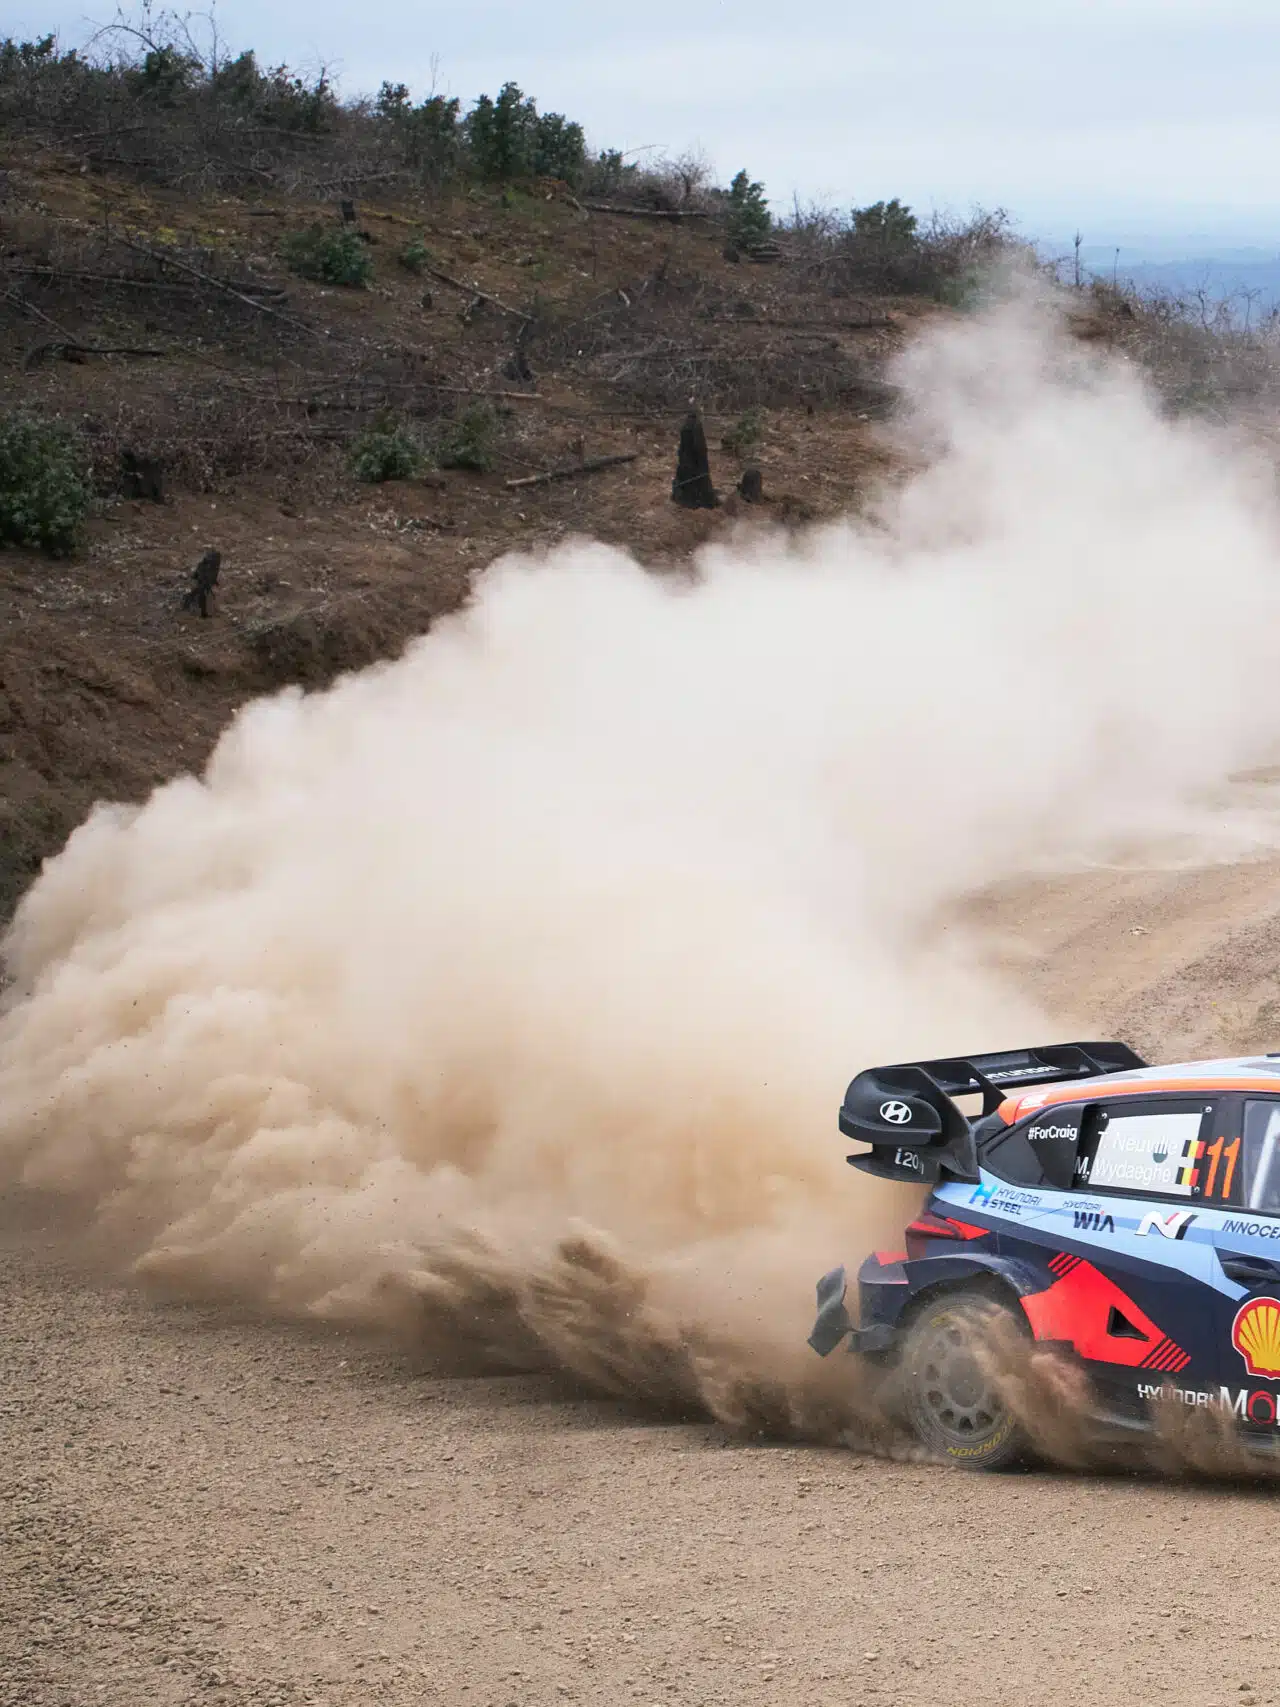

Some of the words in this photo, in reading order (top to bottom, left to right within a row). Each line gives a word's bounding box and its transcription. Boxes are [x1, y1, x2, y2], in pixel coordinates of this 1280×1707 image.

[1028, 1124, 1077, 1141] #ForCraig
[1112, 1132, 1179, 1156] Neuville
[1074, 1156, 1090, 1176] M.
[1094, 1158, 1172, 1186] Wydaeghe
[1206, 1136, 1241, 1199] 11
[990, 1198, 1022, 1216] STEEL
[995, 1187, 1042, 1206] HYUNDAI
[1062, 1200, 1102, 1210] HYUNDAI
[1073, 1210, 1115, 1234] WIA
